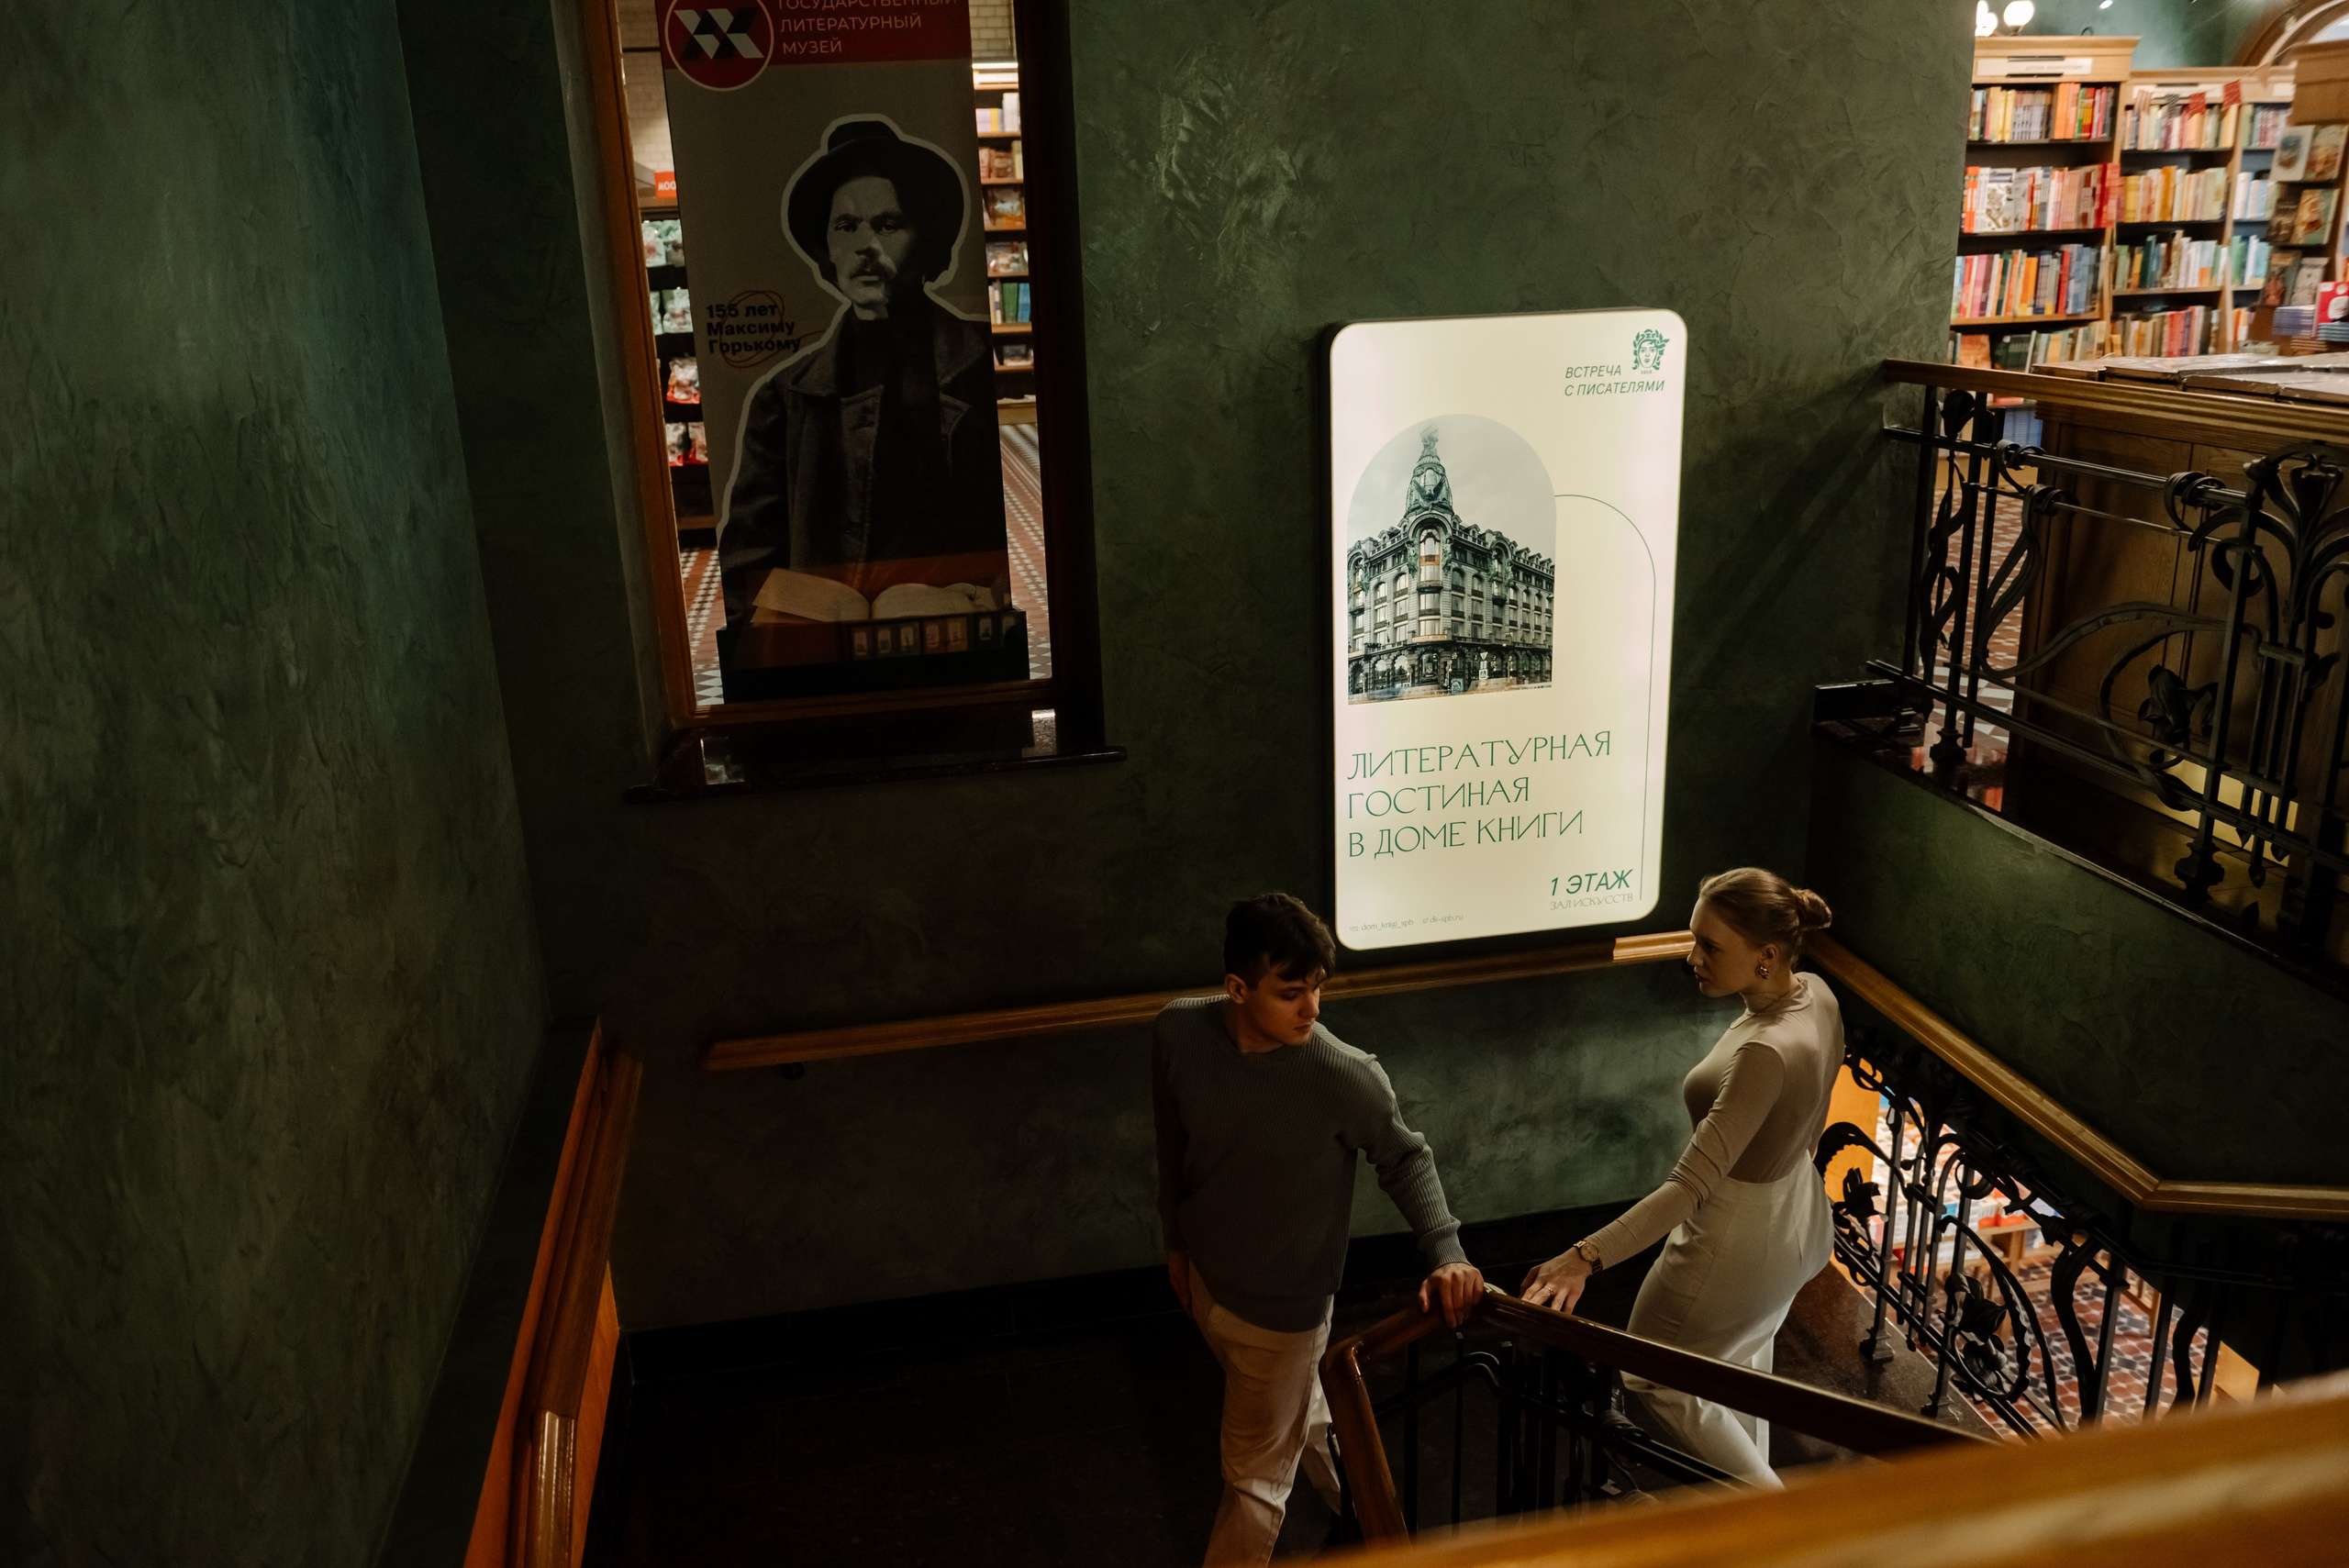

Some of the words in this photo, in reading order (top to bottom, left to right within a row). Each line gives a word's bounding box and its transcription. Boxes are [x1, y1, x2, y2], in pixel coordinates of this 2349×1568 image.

[781, 13, 922, 32] ЛИТЕРАТУРНЫЙ
[783, 38, 842, 54] МУЗЕЙ
[706, 304, 740, 318] 155
[744, 305, 779, 317] лет
[707, 321, 795, 336] Максиму
[708, 339, 801, 356] Горькому
[1565, 364, 1621, 379] ВСТРЕЧА
[1564, 384, 1574, 396] С
[1576, 380, 1665, 395] ПИСАТЕЛЯМИ
[1347, 730, 1612, 780] ЛИТЕРАТУРНАЯ
[1348, 776, 1530, 818] ГОСТИНАЯ
[1349, 831, 1364, 857] В
[1375, 821, 1467, 860] ДОМЕ
[1476, 810, 1583, 844] КНИГИ
[1551, 877, 1558, 896] 1
[1565, 869, 1633, 895] ЭТАЖ
[1550, 901, 1571, 910] ЗАЛ
[1574, 894, 1633, 907] ИСКУССТВ
